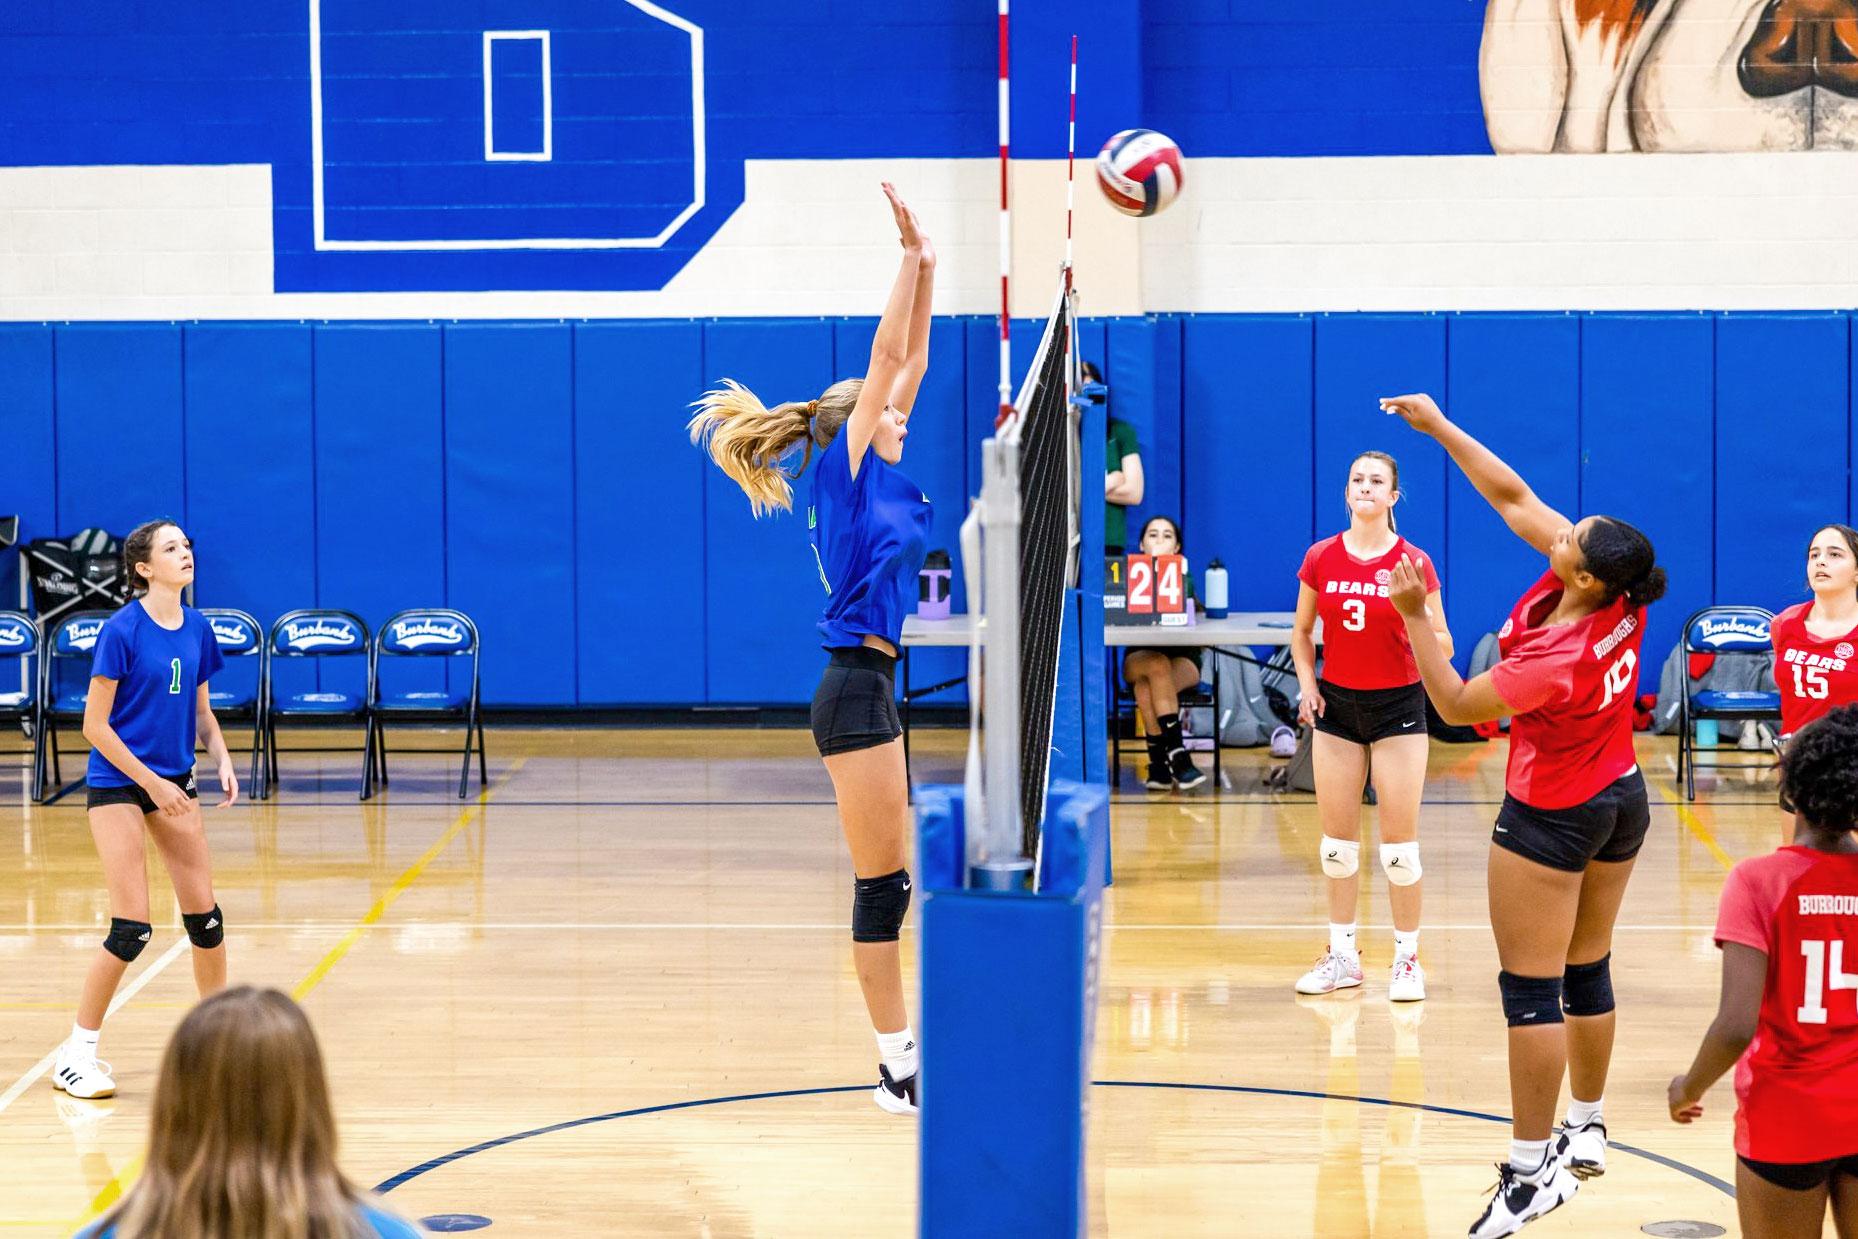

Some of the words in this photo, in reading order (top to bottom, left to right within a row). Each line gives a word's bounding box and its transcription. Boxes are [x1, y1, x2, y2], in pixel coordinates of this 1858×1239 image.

[1110, 561, 1120, 585] 1
[1129, 561, 1180, 605] 24
[1325, 580, 1390, 598] BEARS
[1342, 598, 1366, 632] 3
[1697, 616, 1768, 638] Burbank
[284, 618, 352, 641] Burbank
[392, 618, 459, 640] Burbank
[1783, 648, 1847, 672] BEARS
[169, 657, 181, 695] 1
[1791, 664, 1830, 700] 15
